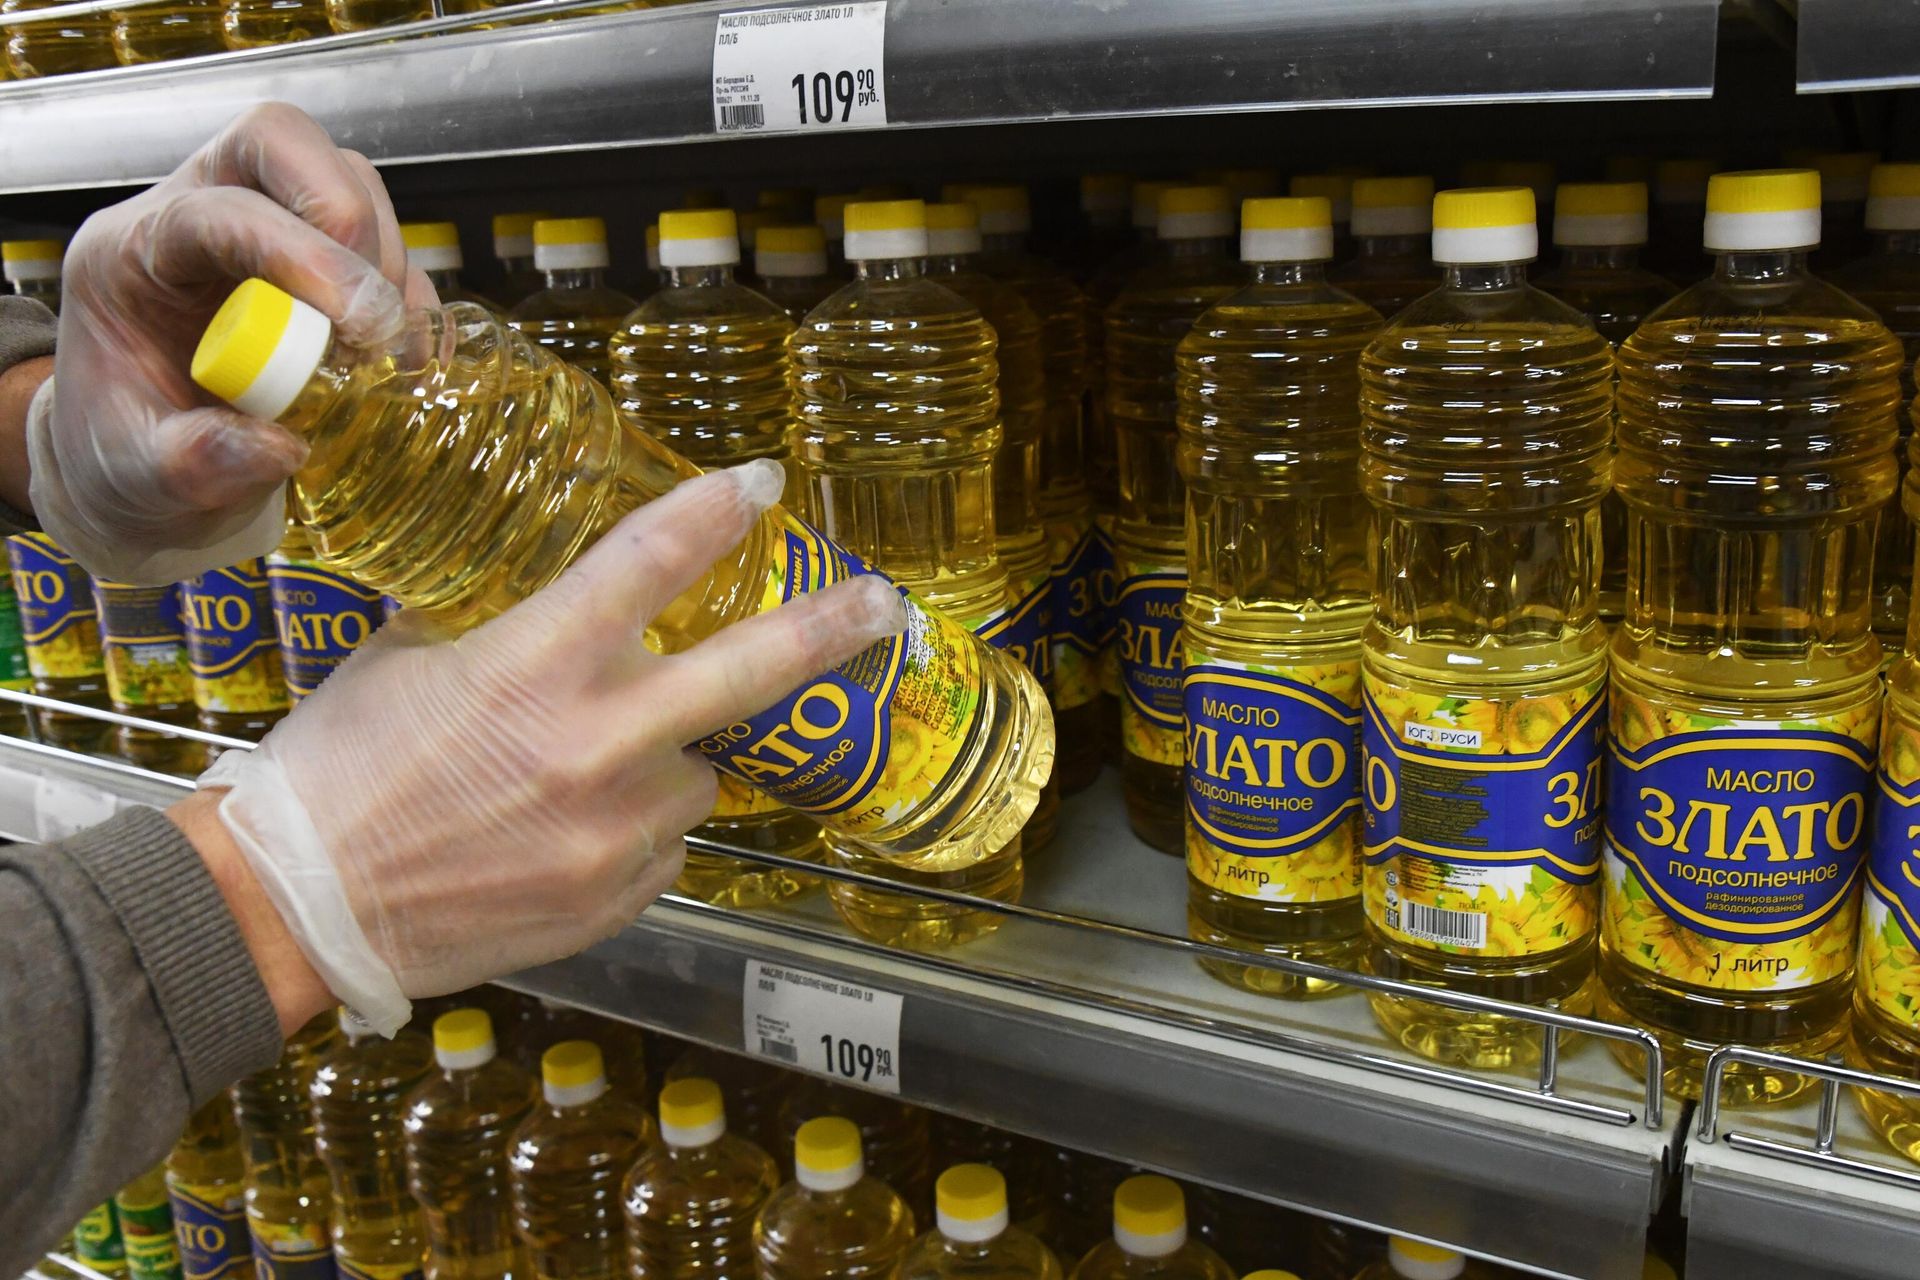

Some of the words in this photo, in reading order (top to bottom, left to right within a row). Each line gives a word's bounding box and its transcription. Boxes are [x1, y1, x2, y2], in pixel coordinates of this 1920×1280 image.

[721, 16, 748, 29] МАСЛО
[750, 11, 812, 27] ПОДСОЛНЕЧНОЕ
[814, 9, 841, 20] ЗЛАТО
[843, 7, 853, 18] 1Л
[719, 33, 738, 46] ПЛ/Б
[791, 70, 855, 125] 109
[857, 69, 874, 90] 90
[858, 89, 880, 107] руб.
[791, 554, 803, 596] ТАМИН
[185, 593, 252, 632] АТО
[1145, 601, 1183, 618] МАС
[1119, 618, 1186, 671] ЗЛА
[1132, 669, 1183, 689] подсол
[1201, 696, 1280, 729] МАСЛО
[700, 722, 752, 754] СЛО
[730, 683, 850, 783] АТО
[1408, 726, 1426, 739] ЮГ
[1440, 732, 1477, 745] РУСИ
[774, 738, 855, 793] лнечное
[1189, 774, 1314, 812] подсолнечное
[1706, 767, 1816, 794] МАСЛО
[1635, 786, 1866, 862] ЗЛАТО
[1227, 865, 1270, 888] литр
[1668, 860, 1839, 889] подсолнечное
[1704, 901, 1805, 914] дезодорированное
[1706, 891, 1805, 905] рафинированное
[1711, 952, 1722, 971] 1
[1732, 956, 1790, 976] литр
[821, 1034, 874, 1082] 109
[876, 1047, 891, 1065] 90
